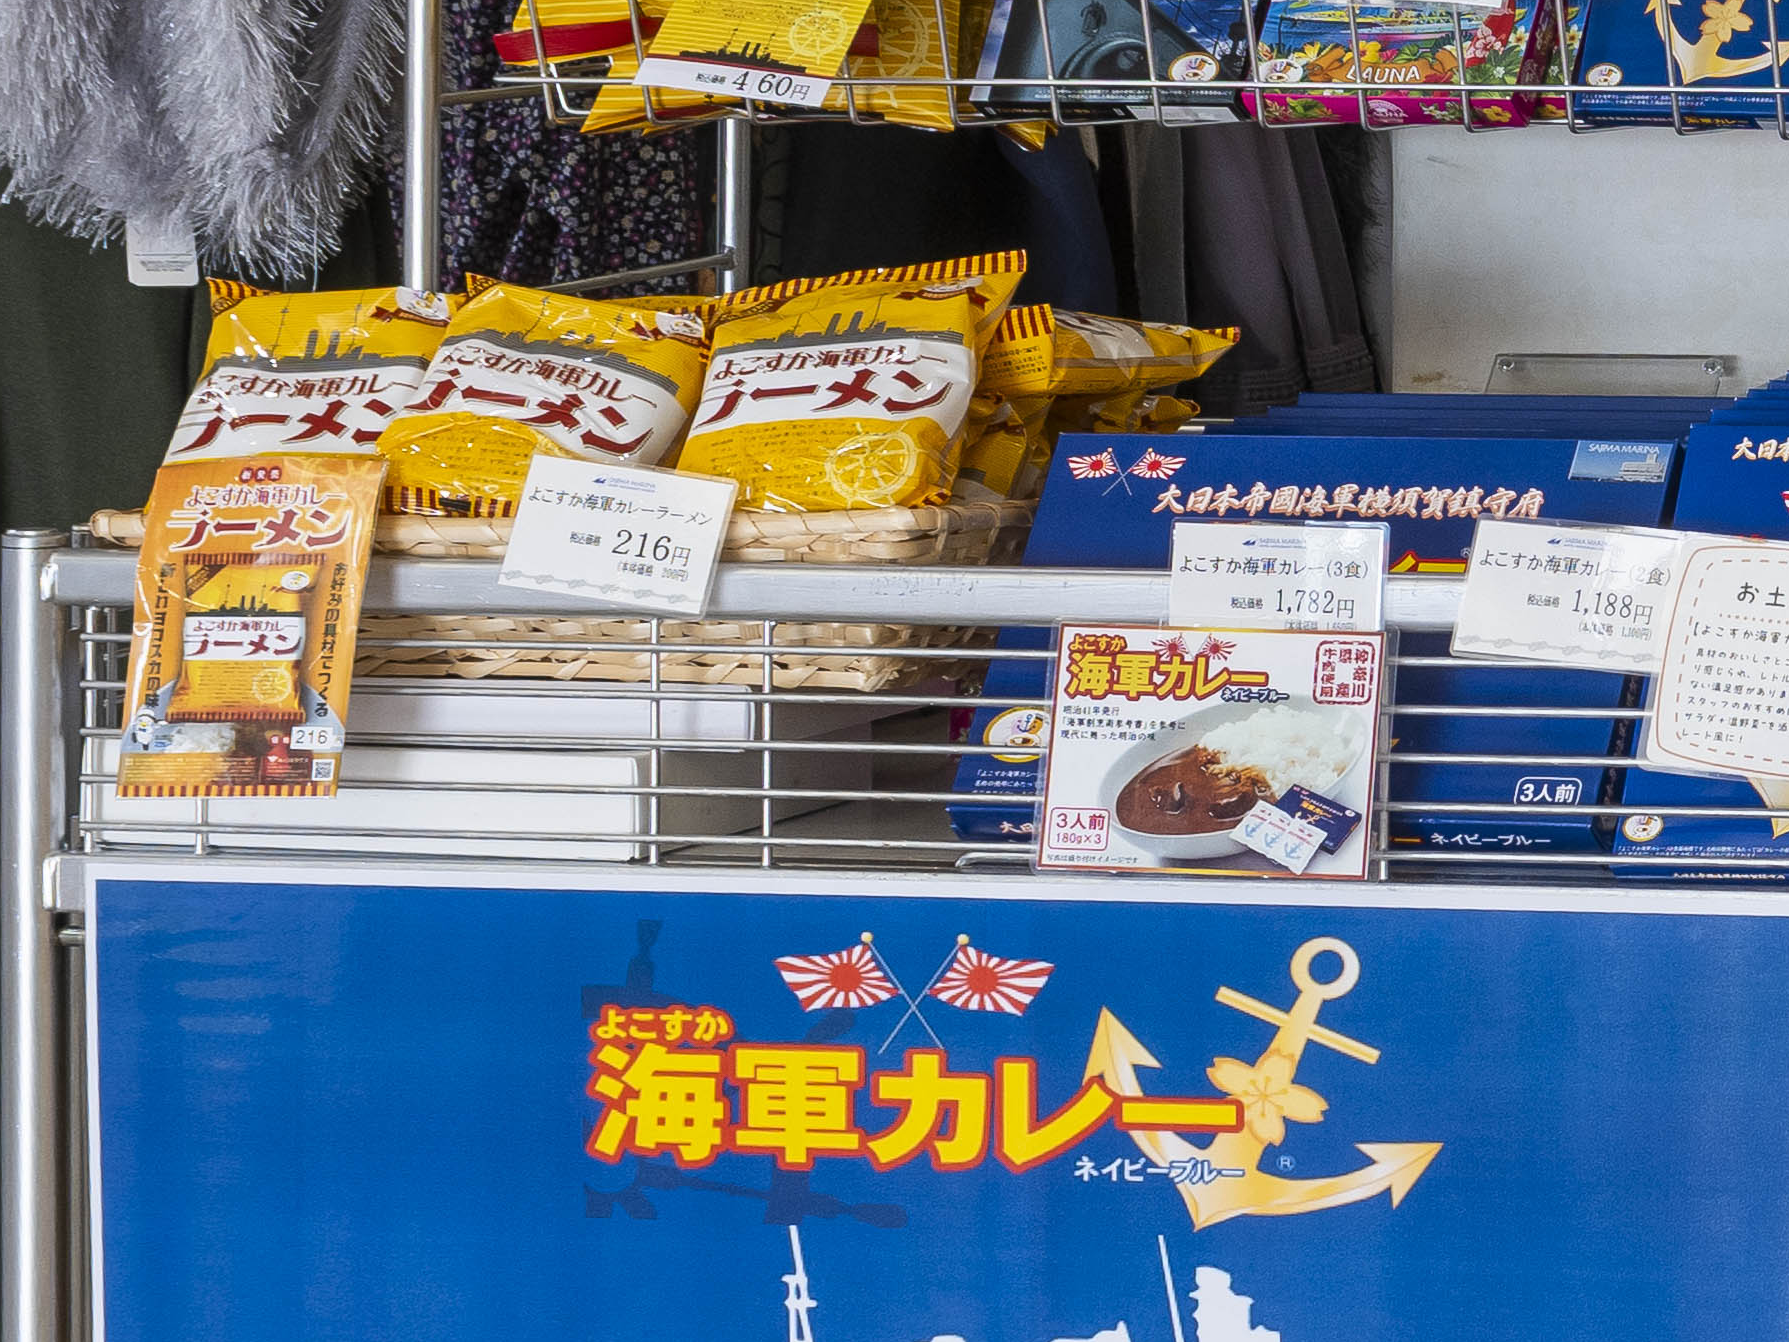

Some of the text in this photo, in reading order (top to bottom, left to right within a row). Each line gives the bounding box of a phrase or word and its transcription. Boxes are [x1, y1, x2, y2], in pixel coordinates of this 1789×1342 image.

[1346, 61, 1423, 85] LAUNA
[186, 485, 347, 509] よこすか海軍カレー
[529, 489, 714, 528] よこすか海軍カレーラーメン
[168, 507, 352, 552] ラーメン
[613, 529, 691, 569] 216円
[1068, 634, 1128, 651] よこすか
[1065, 651, 1269, 702] 海軍カレー
[1519, 782, 1576, 804] 3人前
[1056, 812, 1105, 833] 3人前
[1430, 832, 1551, 848] ネイビーブルー
[592, 1003, 732, 1042] よこすか
[585, 1038, 1246, 1174] 海軍カレー
[1072, 1153, 1246, 1189] ネイビーブルー
